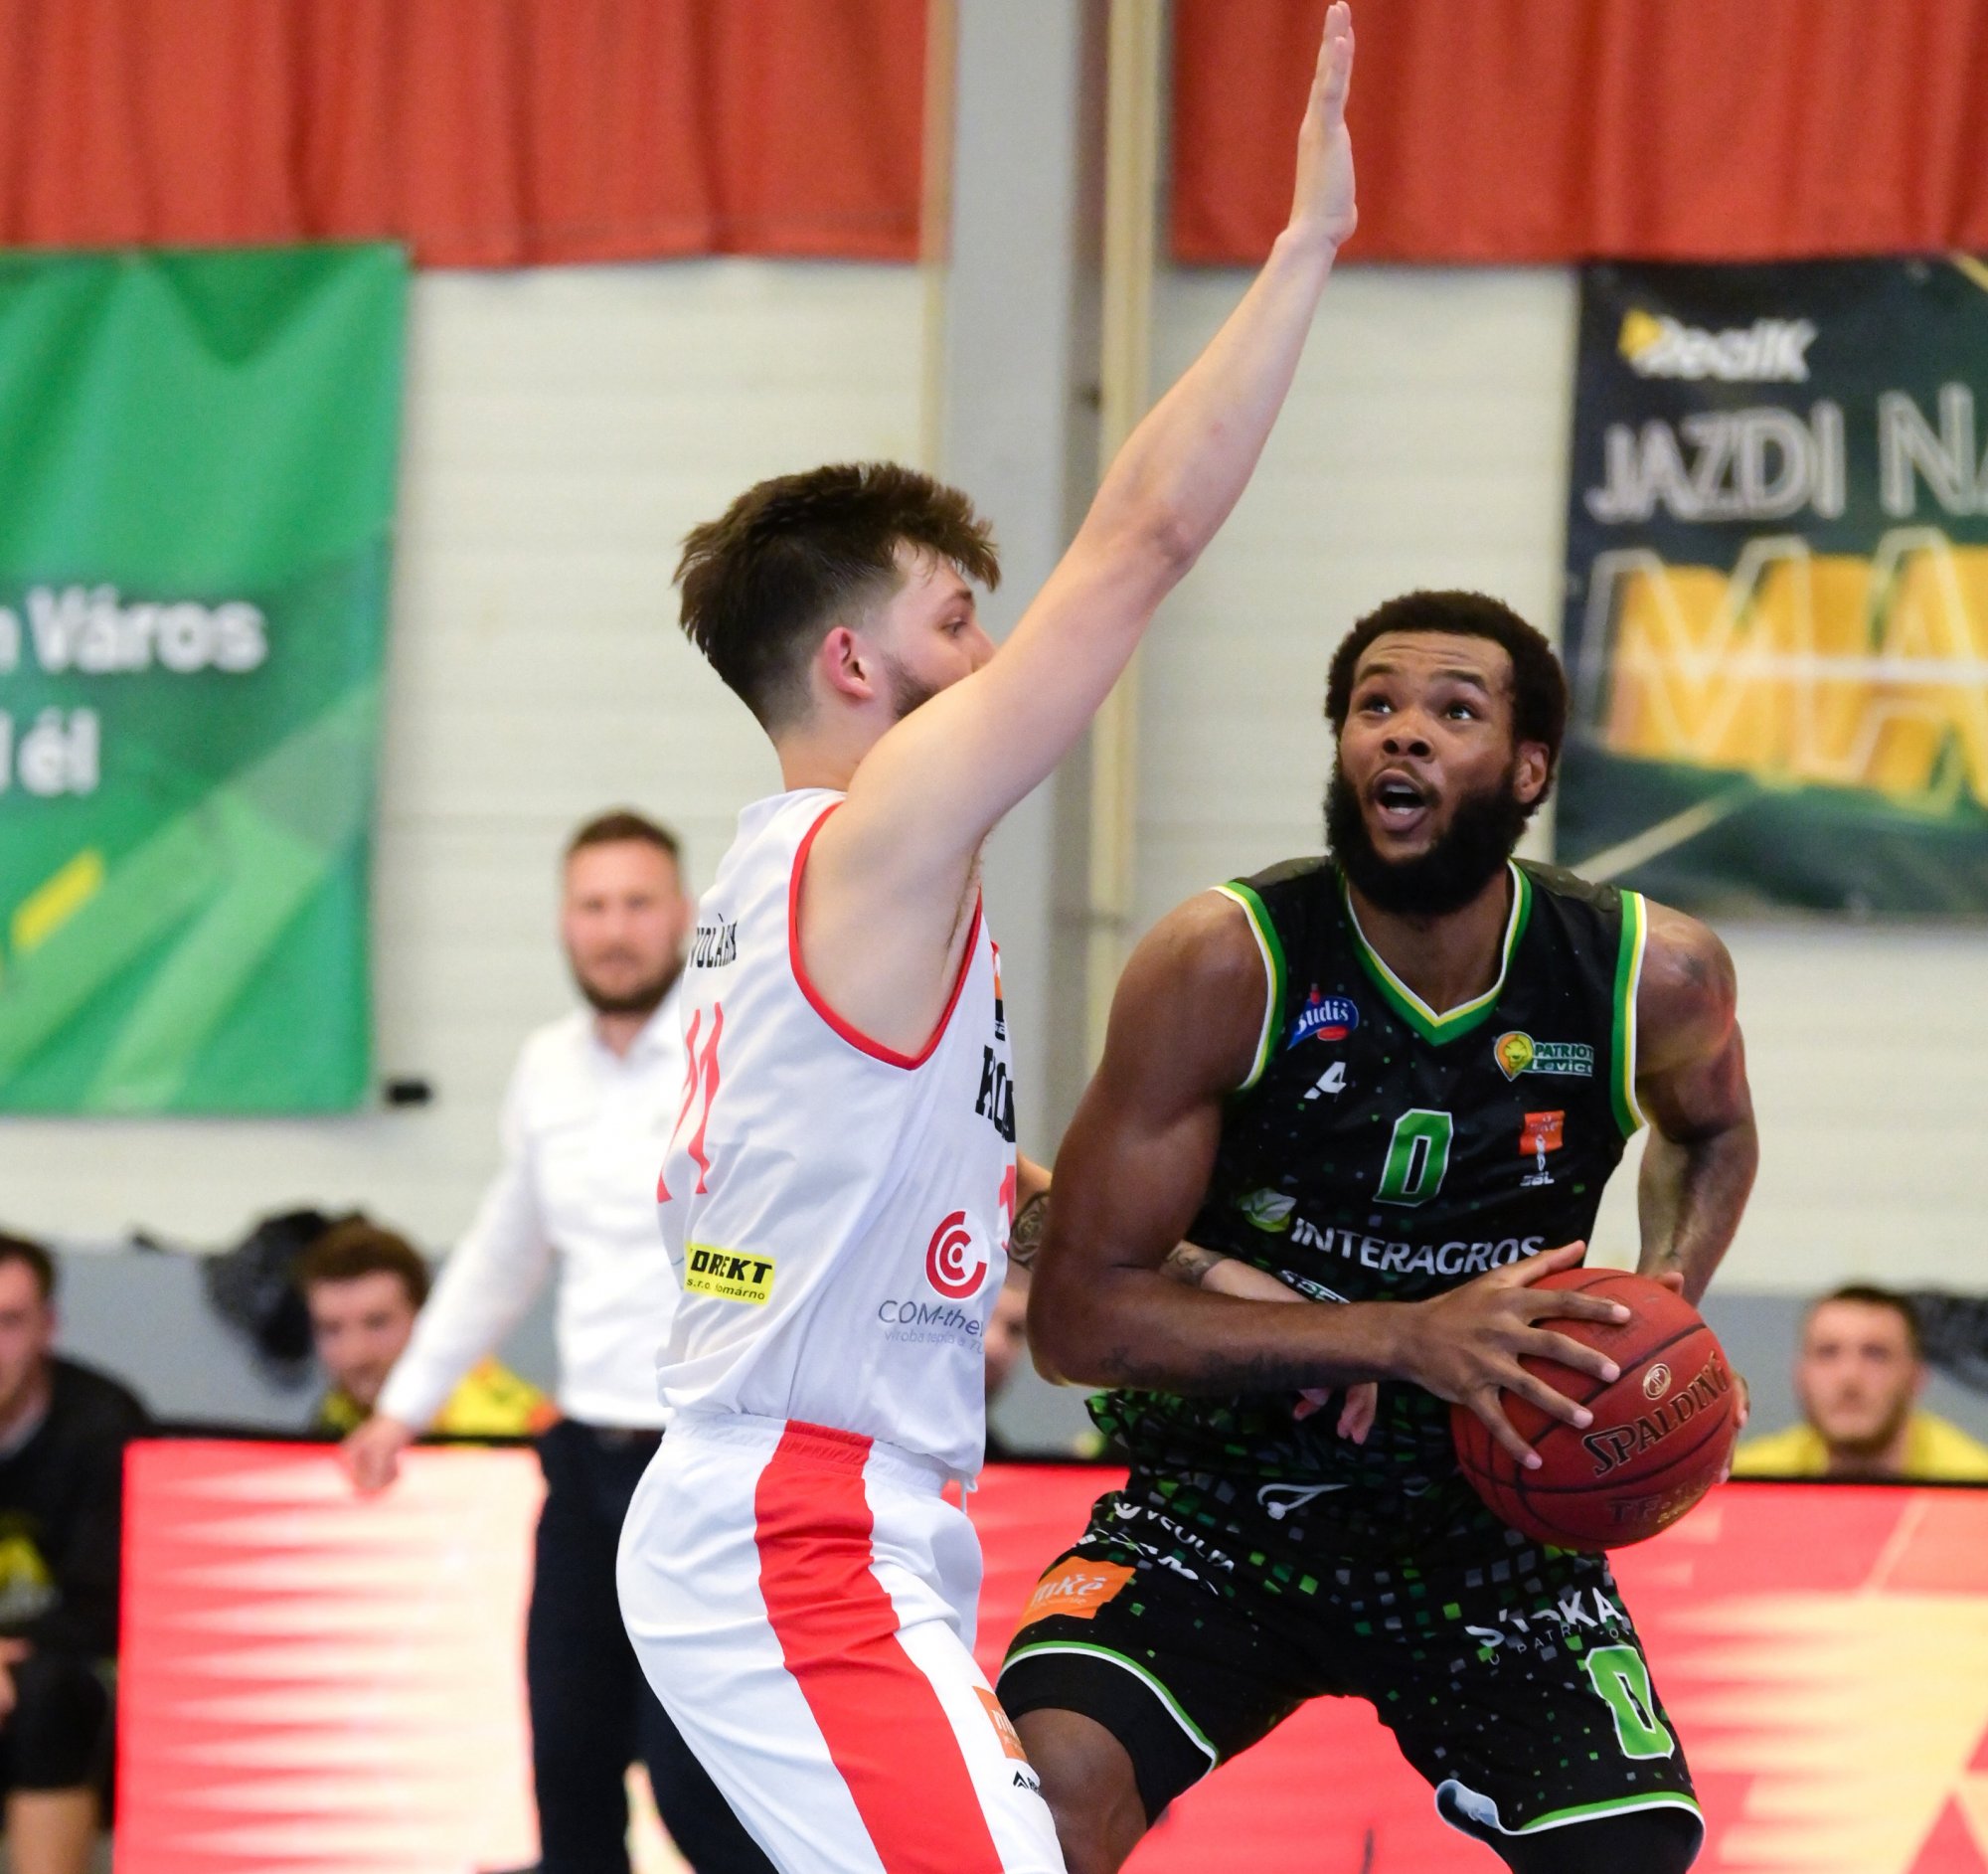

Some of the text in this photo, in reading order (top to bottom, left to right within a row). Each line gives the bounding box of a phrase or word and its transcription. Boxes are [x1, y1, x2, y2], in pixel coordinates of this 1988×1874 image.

[1585, 400, 1846, 524] JAZDI
[27, 584, 268, 674] Város
[1373, 1107, 1453, 1208] 0
[1291, 1217, 1546, 1276] INTERAGROS
[1581, 1349, 1731, 1476] SPALDING
[1584, 1645, 1675, 1760] 0
